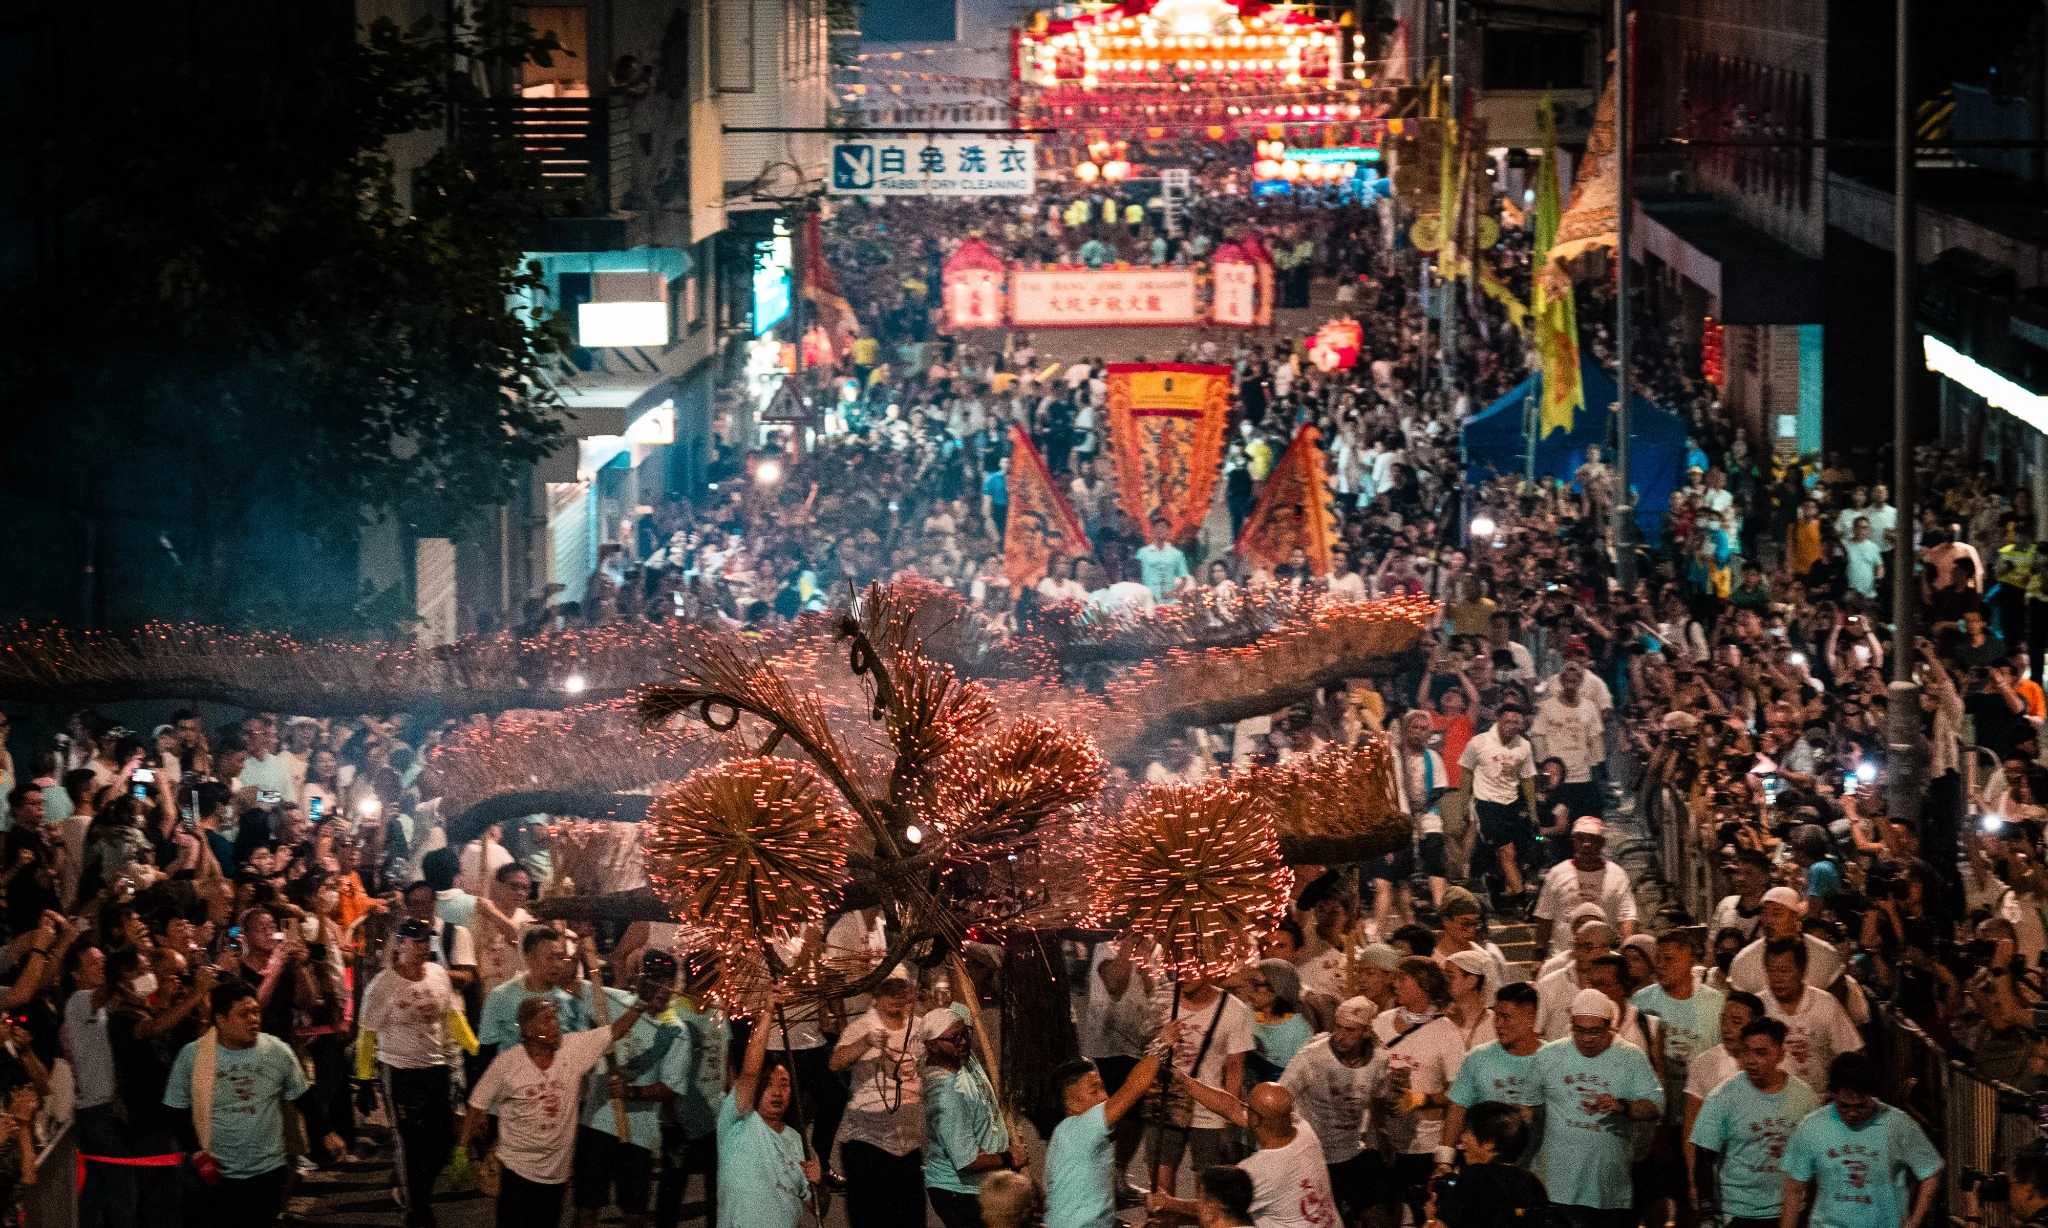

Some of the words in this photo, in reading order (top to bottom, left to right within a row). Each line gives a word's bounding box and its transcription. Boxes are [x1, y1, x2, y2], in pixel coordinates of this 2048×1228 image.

[880, 145, 1026, 174] 白兔洗衣
[931, 179, 956, 189] DRY
[961, 179, 1027, 189] CLEANING
